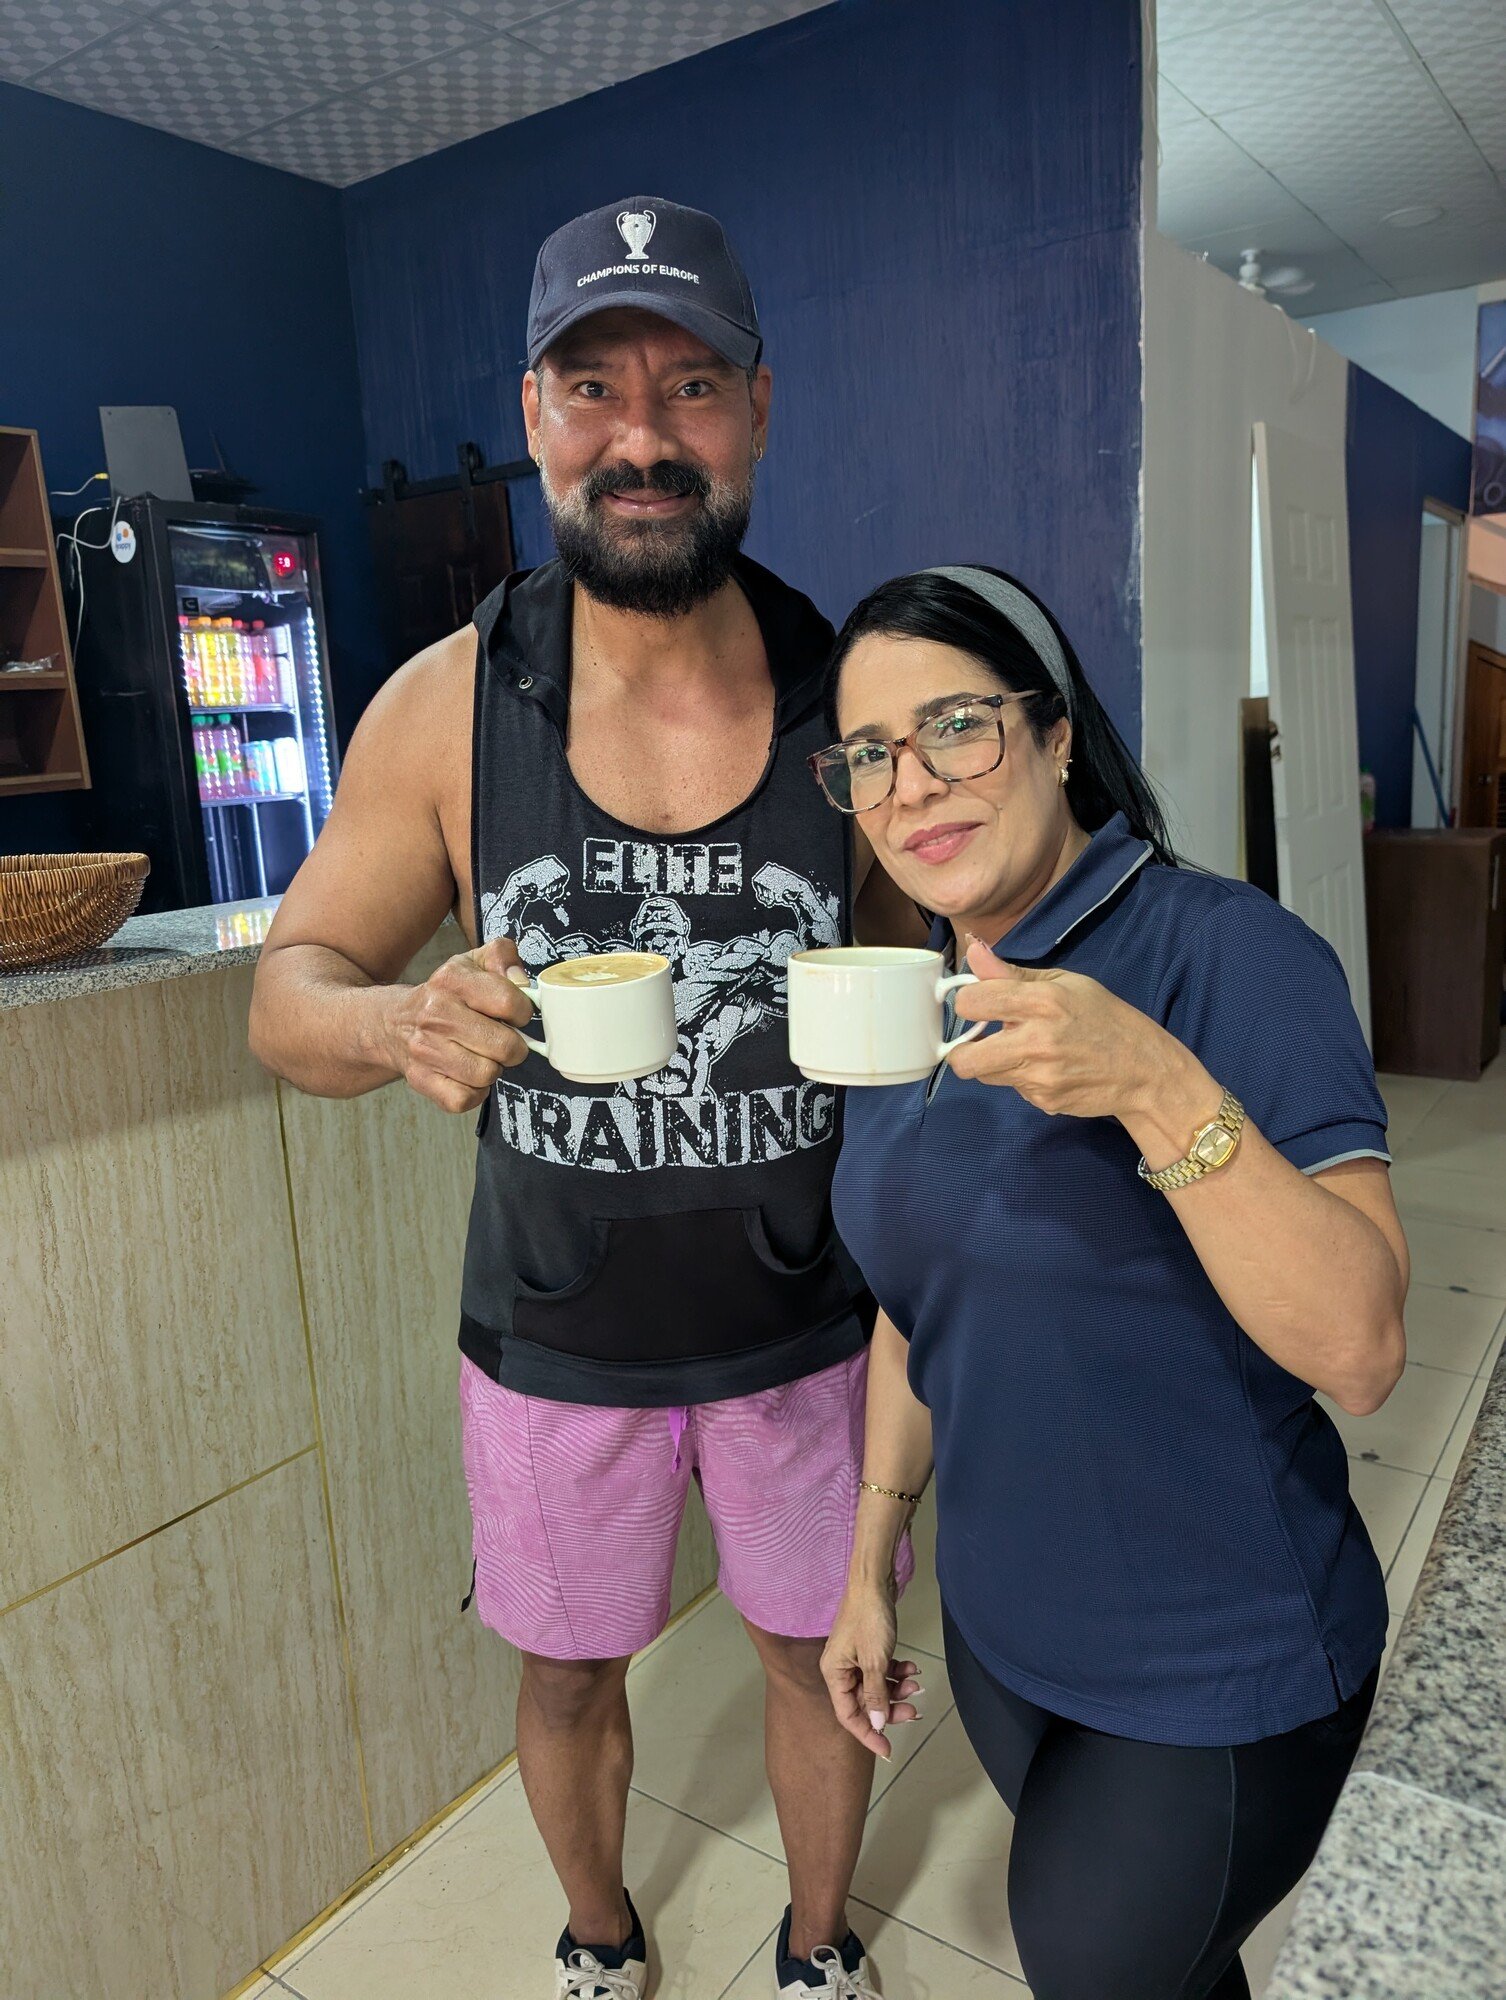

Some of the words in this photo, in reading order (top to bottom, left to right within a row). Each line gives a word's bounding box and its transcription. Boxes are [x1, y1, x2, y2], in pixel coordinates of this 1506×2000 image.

[577, 264, 640, 287] CHAMPIONS
[641, 264, 658, 274] OF
[659, 265, 700, 285] EUROPE
[583, 837, 743, 895] ELITE
[497, 1077, 835, 1173] TRAINING
